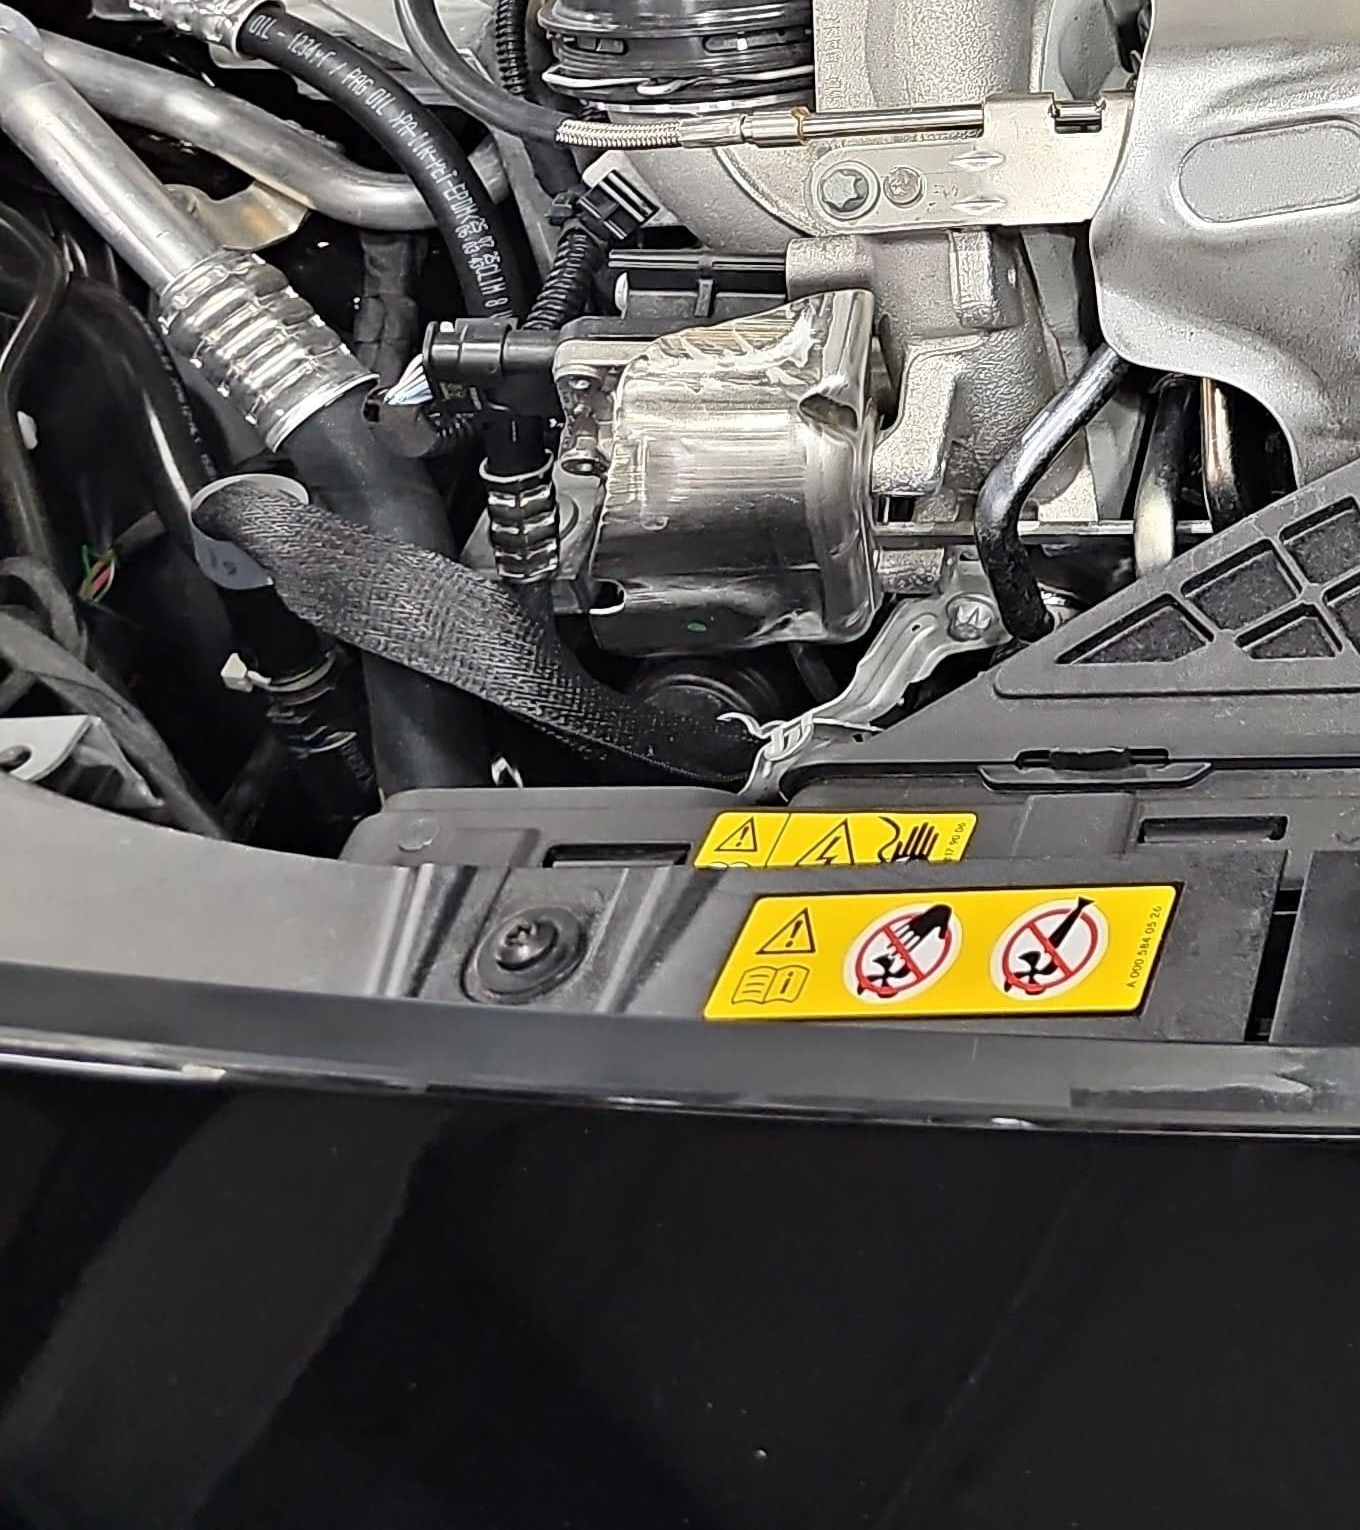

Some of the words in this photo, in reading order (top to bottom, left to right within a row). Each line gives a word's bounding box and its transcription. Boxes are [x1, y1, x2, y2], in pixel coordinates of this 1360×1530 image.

[248, 14, 278, 40] OIL
[341, 66, 375, 96] PAG
[365, 87, 397, 117] OIL
[1129, 958, 1146, 979] 000
[1144, 921, 1157, 935] 05
